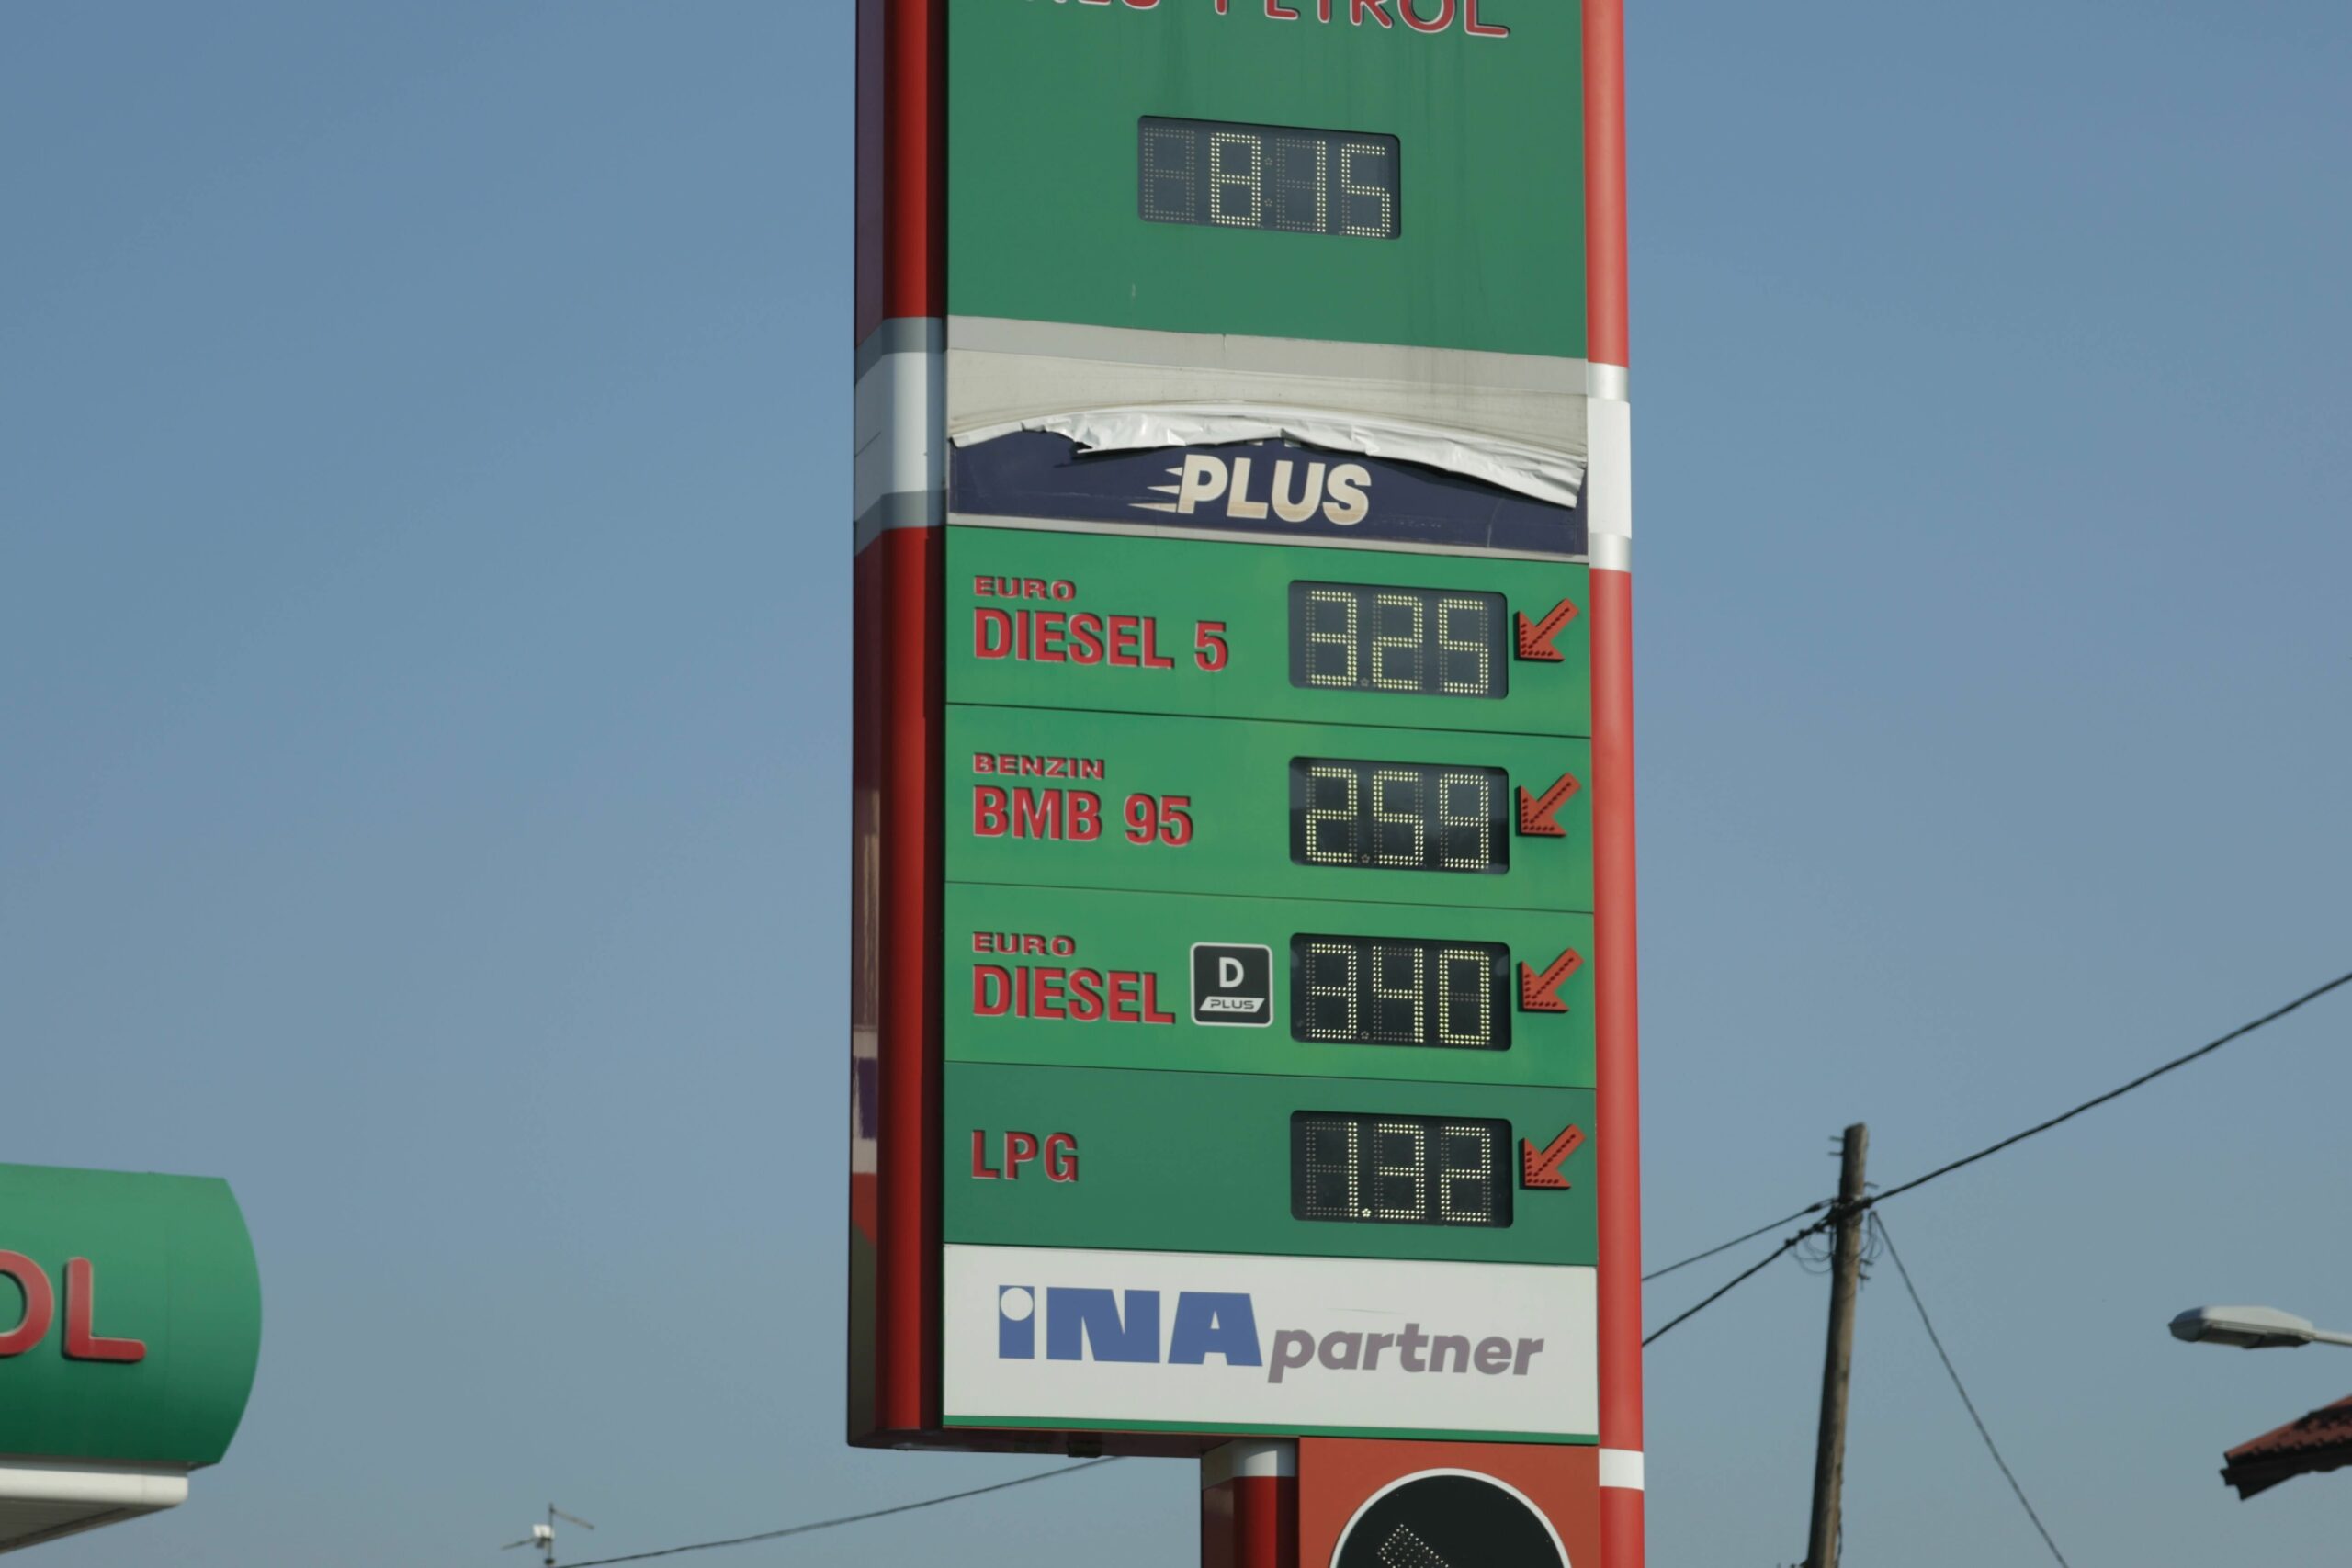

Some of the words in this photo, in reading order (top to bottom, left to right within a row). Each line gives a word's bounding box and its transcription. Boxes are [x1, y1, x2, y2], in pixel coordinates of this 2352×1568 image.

[1177, 453, 1372, 525] PLUS
[974, 575, 1076, 602] EURO
[974, 607, 1175, 670] DIESEL
[1195, 620, 1228, 672] 5
[973, 752, 1104, 780] BENZIN
[973, 784, 1102, 842] BMB
[1124, 793, 1193, 846] 95
[972, 931, 1075, 958] EURO
[1219, 956, 1244, 987] D
[972, 964, 1176, 1025] DIESEL
[1209, 998, 1255, 1010] PLUS
[971, 1129, 1080, 1183] LPG
[1347, 1121, 1492, 1223] 1.32
[1267, 1322, 1545, 1384] partner
